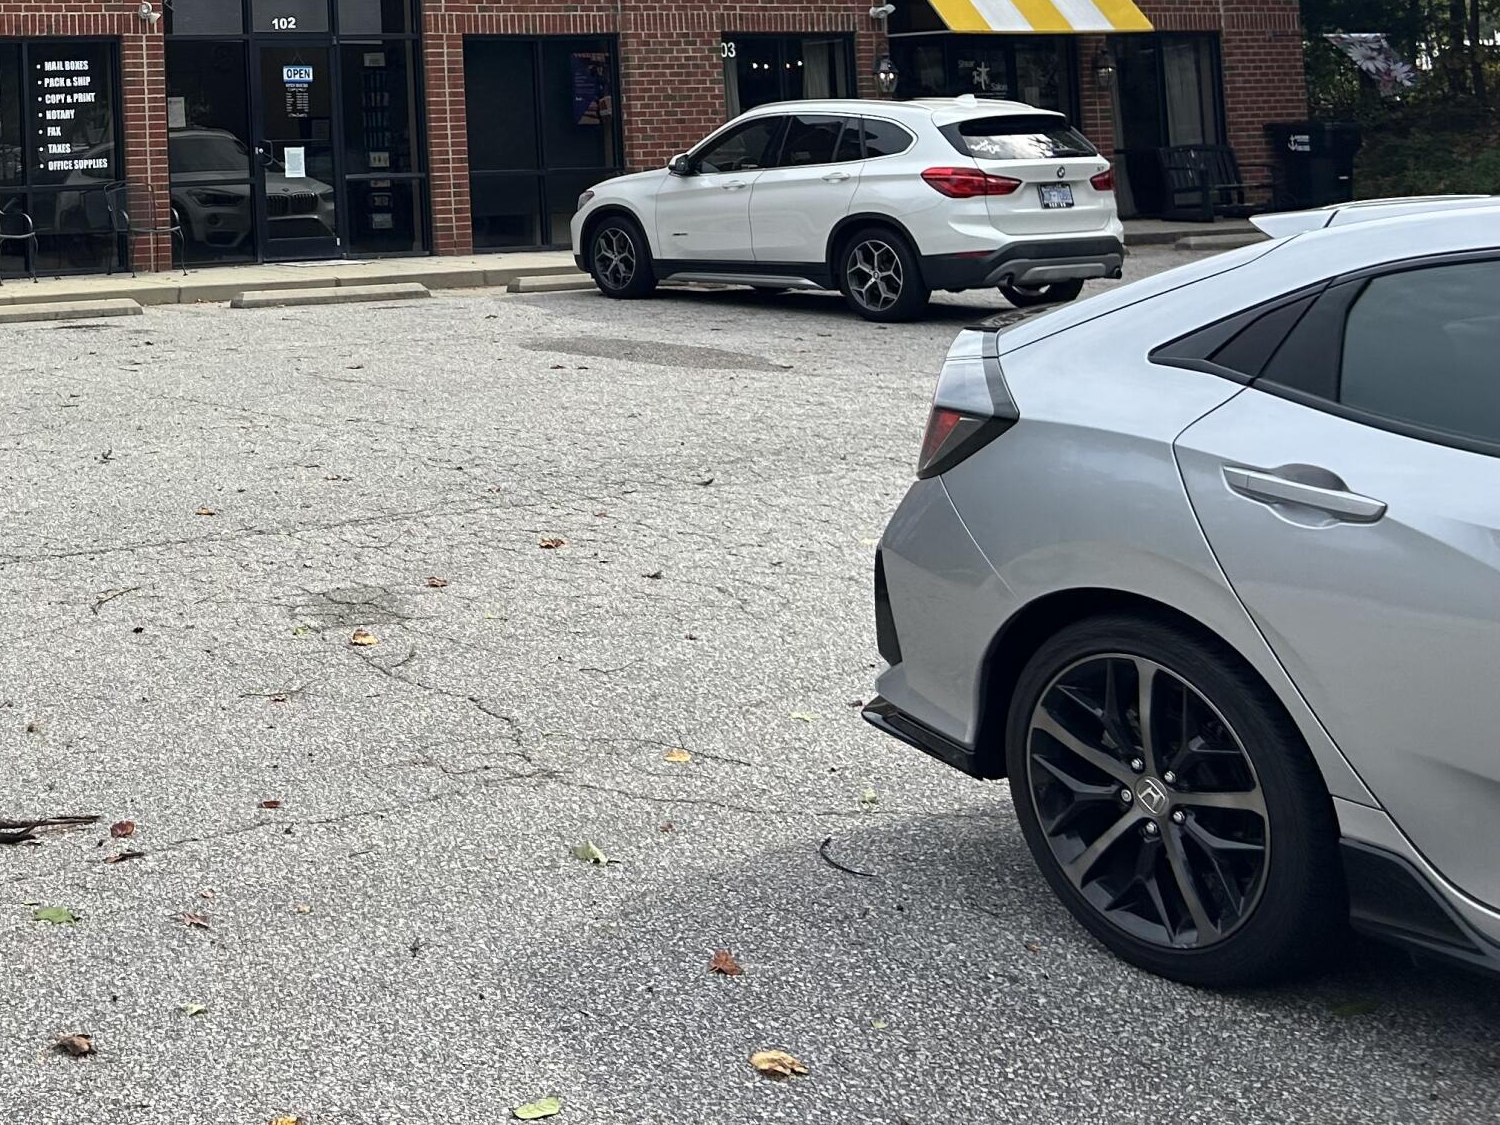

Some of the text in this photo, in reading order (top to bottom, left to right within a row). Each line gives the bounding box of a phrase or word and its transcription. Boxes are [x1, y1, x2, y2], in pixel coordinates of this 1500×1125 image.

[271, 16, 296, 30] 102
[44, 60, 89, 71] MAIL BOXES
[286, 68, 310, 79] OPEN
[44, 76, 91, 88] PACK & SHIP
[45, 92, 96, 104] COPY & PRINT
[46, 109, 75, 119] NOTARY
[47, 126, 62, 137] FAX
[47, 143, 71, 154] TAXES
[48, 158, 108, 171] OFFICE SUPPLIES
